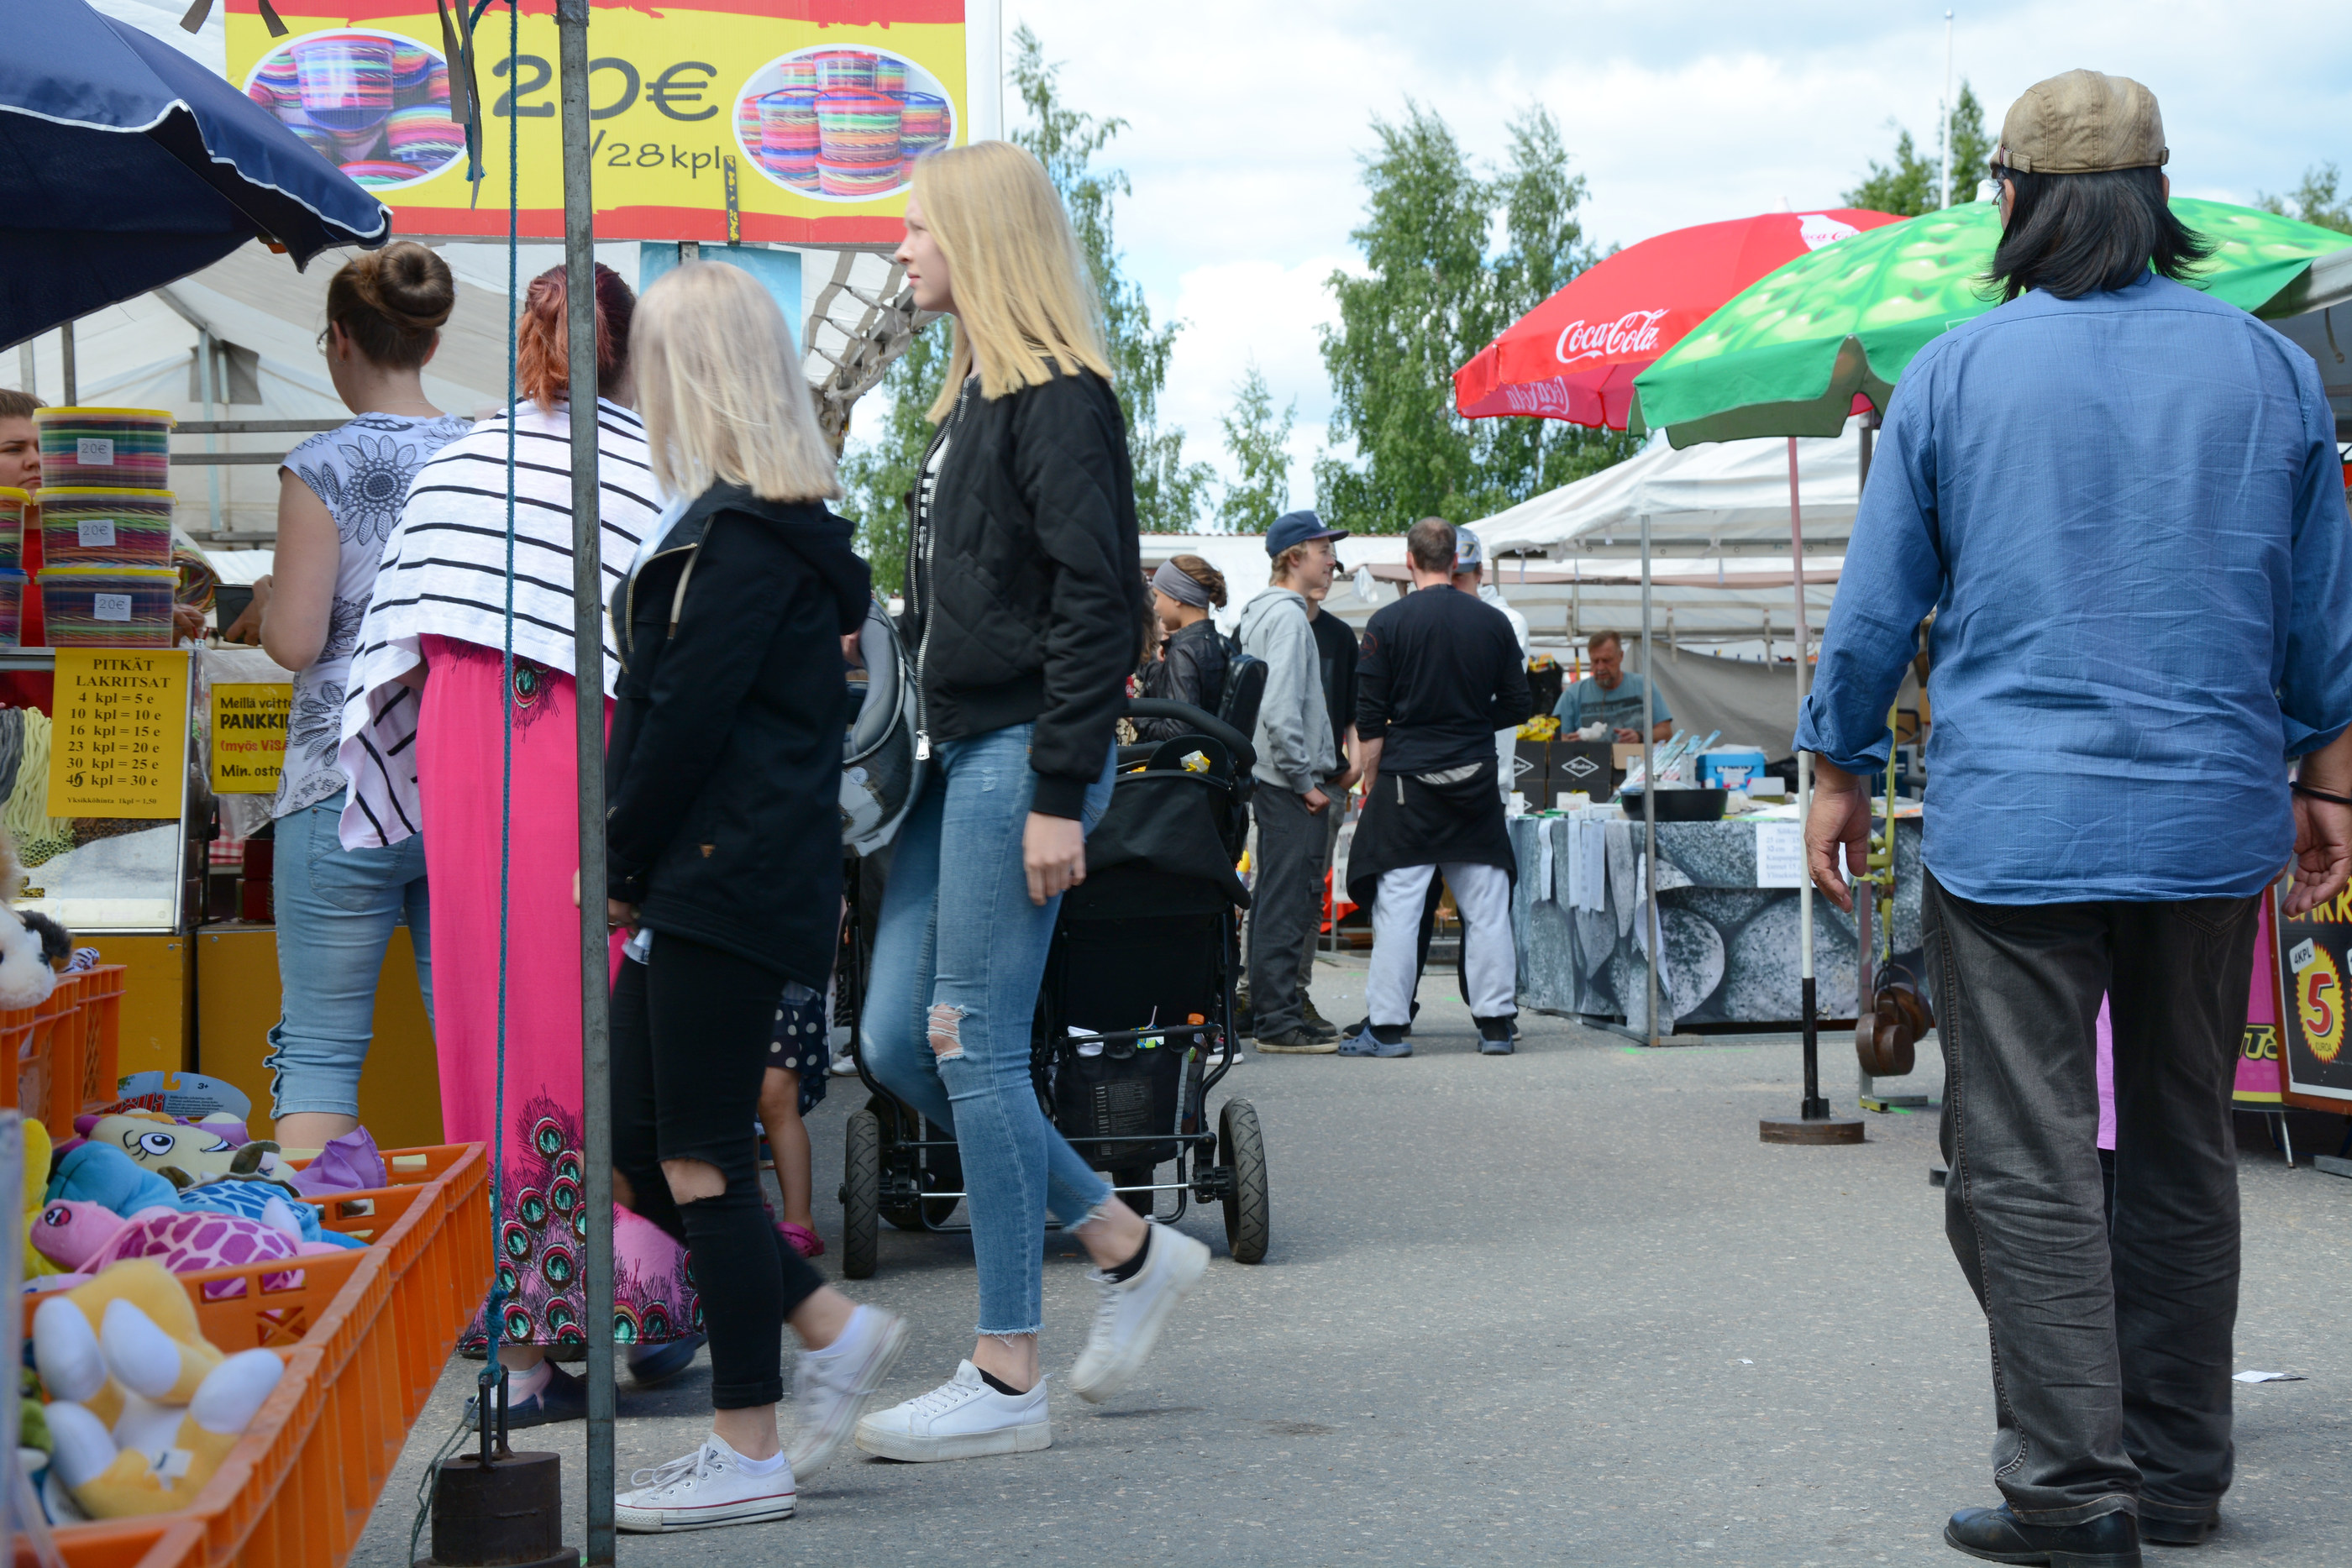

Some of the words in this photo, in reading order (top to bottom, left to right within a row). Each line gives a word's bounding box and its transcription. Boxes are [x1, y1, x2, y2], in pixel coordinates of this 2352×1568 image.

[492, 54, 719, 122] 20€
[1556, 308, 1670, 364] Coca-Cola
[81, 443, 108, 454] 20€
[82, 525, 108, 536] 20€
[98, 599, 125, 610] 20€
[93, 658, 154, 671] PITKÄT
[76, 675, 171, 688] LAKRITSAT
[78, 692, 87, 702] 4
[96, 692, 117, 705] kpl
[134, 693, 143, 704] 5
[220, 697, 255, 709] Meillä
[71, 708, 86, 719] 10
[94, 709, 116, 722] kpl
[135, 710, 150, 720] 10
[220, 713, 289, 729] PANKKI
[70, 725, 85, 735] 16
[94, 726, 115, 738] kpl
[134, 726, 149, 737] 15
[68, 742, 83, 752] 23
[93, 742, 114, 755] kpl
[133, 742, 148, 753] 20
[67, 758, 82, 768] 30
[92, 758, 113, 771] kpl
[132, 759, 147, 769] 25
[221, 764, 251, 777] Min.
[92, 774, 113, 788] kpl
[130, 775, 146, 786] 30
[2294, 947, 2312, 965] 4KPL
[2306, 971, 2334, 1037] 5
